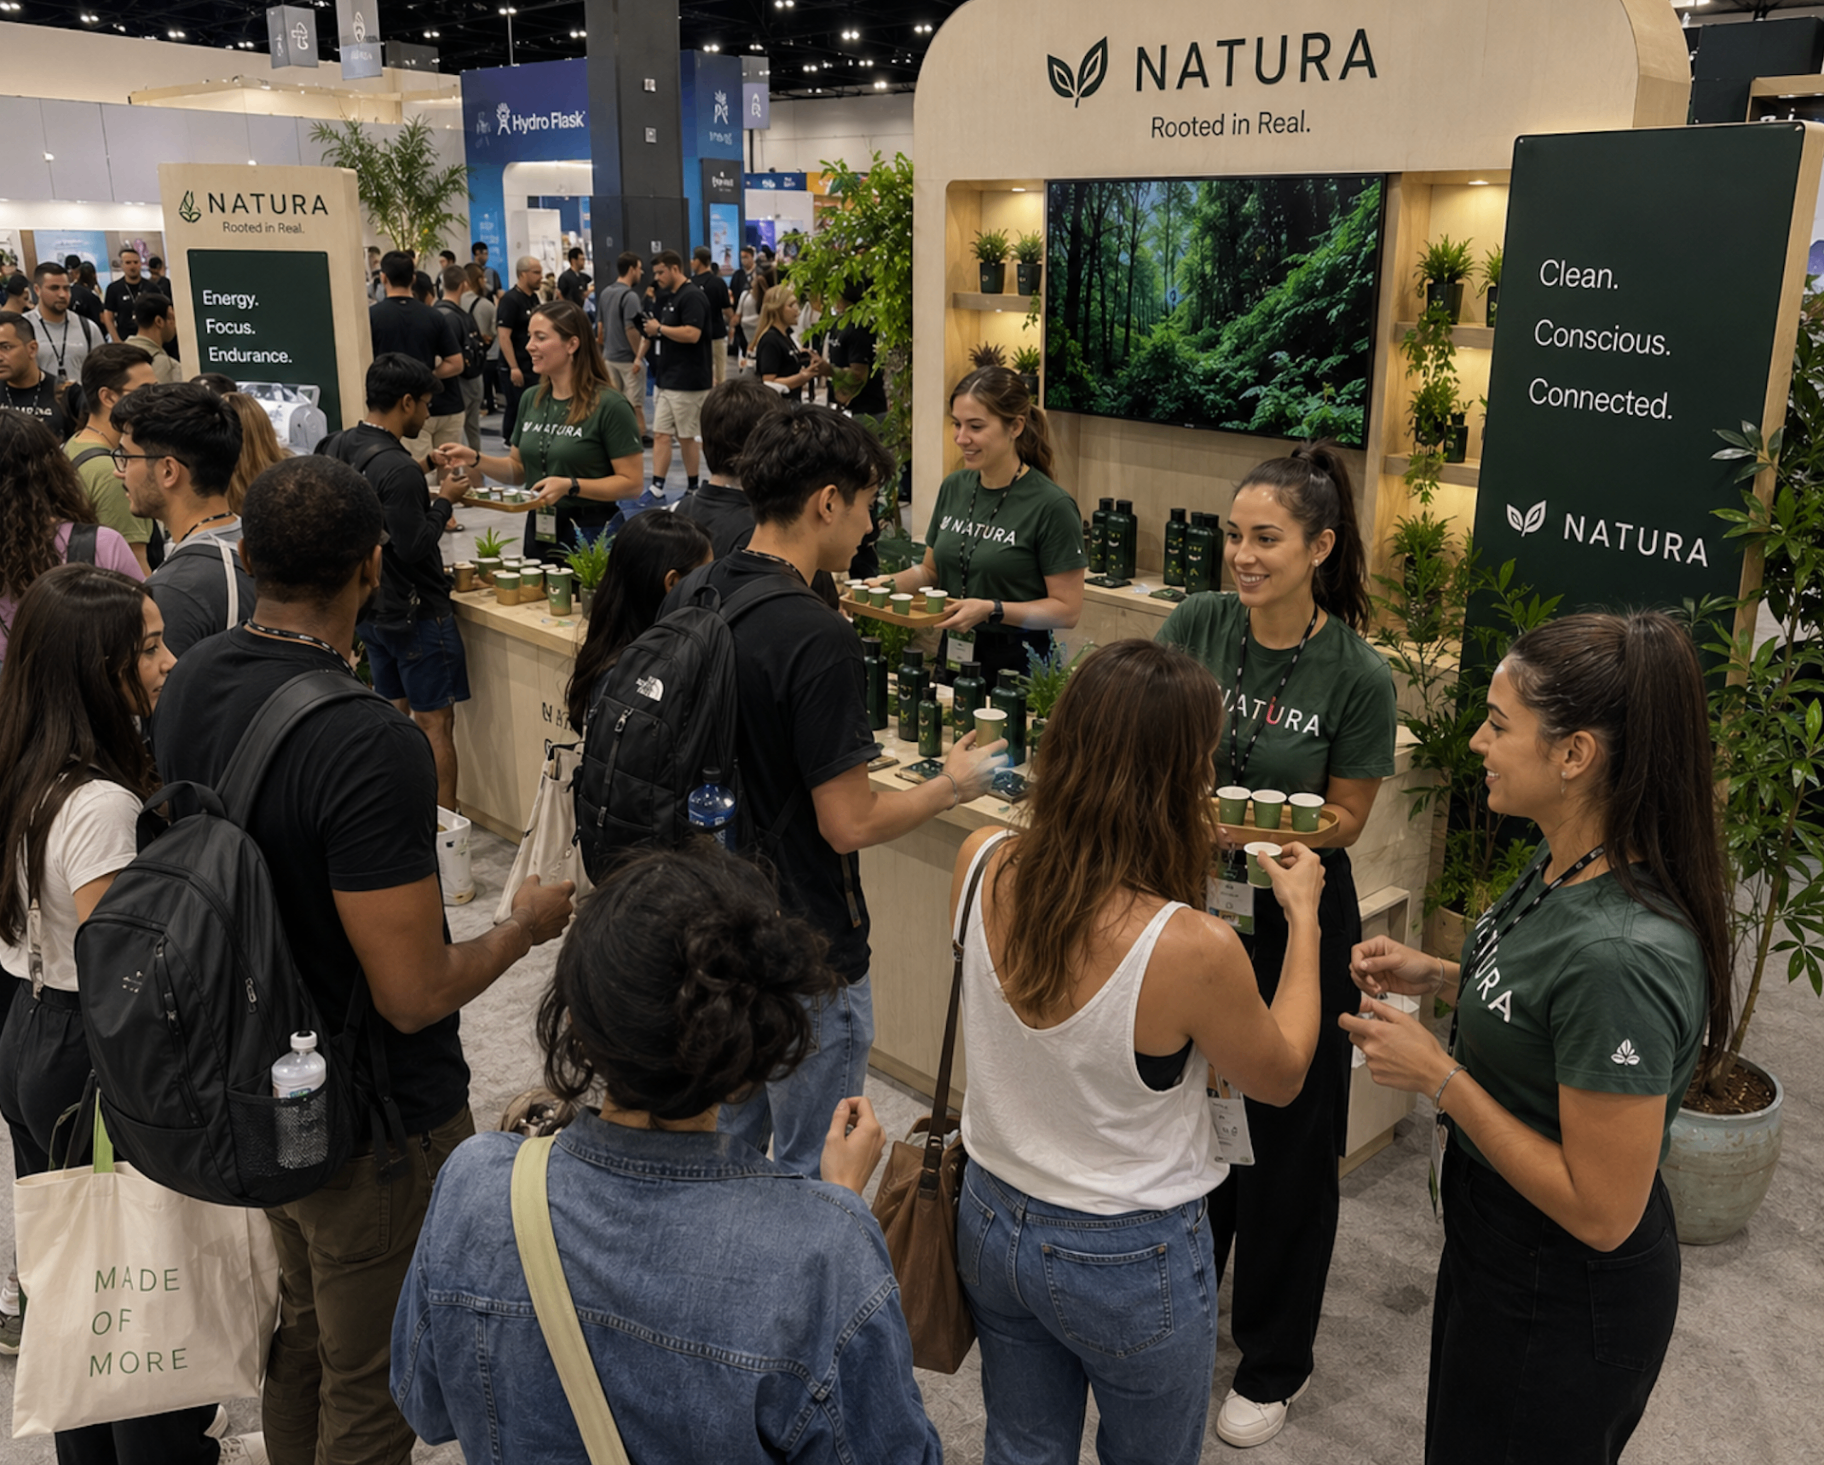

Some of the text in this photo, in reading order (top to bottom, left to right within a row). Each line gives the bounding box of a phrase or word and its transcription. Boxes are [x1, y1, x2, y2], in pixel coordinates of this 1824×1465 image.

[1136, 28, 1378, 92] NATURA
[512, 110, 585, 135] Hydro Flask
[1151, 109, 1311, 138] Rooted in Real.
[207, 192, 329, 215] NATURA
[222, 221, 305, 234] Rooted in Real.
[1539, 258, 1619, 290] Clean.
[202, 289, 259, 310] Energy.
[205, 318, 256, 335] Focus.
[1534, 318, 1671, 357] Conscious.
[208, 346, 292, 364] Endurance.
[1528, 377, 1673, 420] Connected.
[531, 423, 583, 438] NATURA
[950, 518, 1016, 546] NATURA
[1563, 512, 1709, 568] NATURA
[94, 1265, 181, 1293] MADE
[91, 1307, 133, 1336] OF
[89, 1347, 189, 1378] MORE
